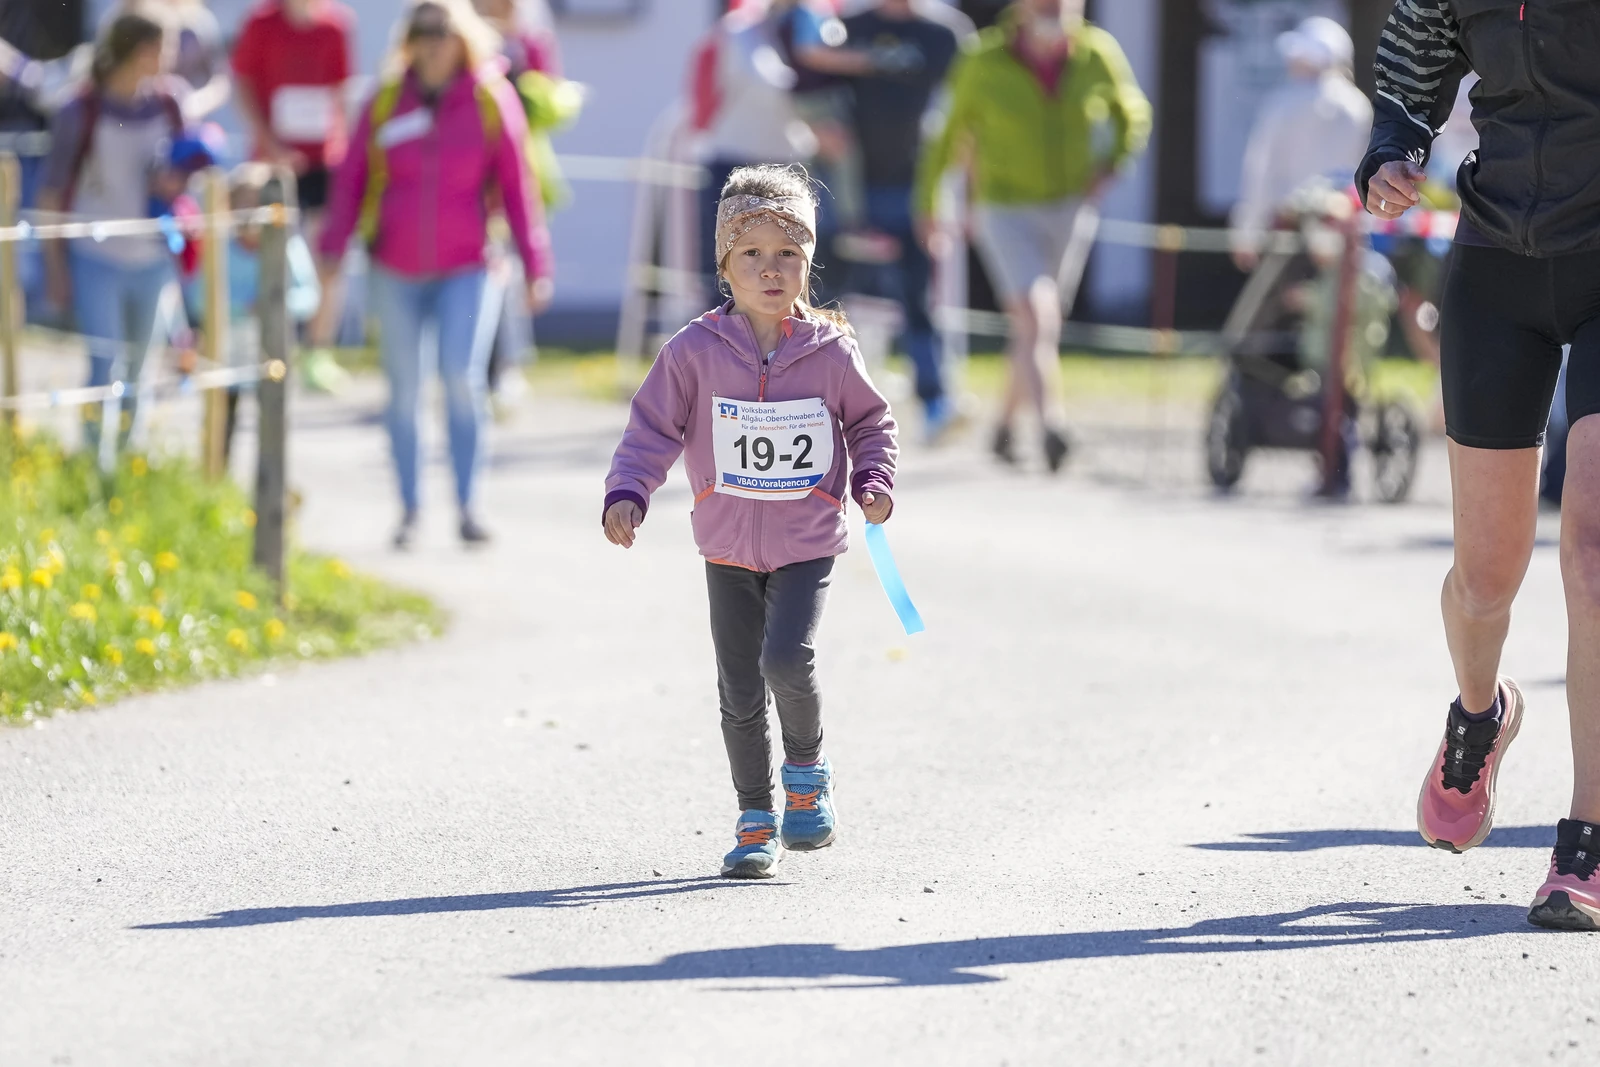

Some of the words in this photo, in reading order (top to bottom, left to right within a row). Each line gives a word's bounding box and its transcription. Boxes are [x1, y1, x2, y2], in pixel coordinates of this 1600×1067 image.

[741, 406, 776, 414] Volksbank
[741, 412, 815, 423] Allgäu-Oberschwaben
[816, 410, 824, 418] eG
[734, 434, 813, 471] 19-2
[737, 476, 758, 487] VBAO
[759, 479, 809, 488] Voralpencup
